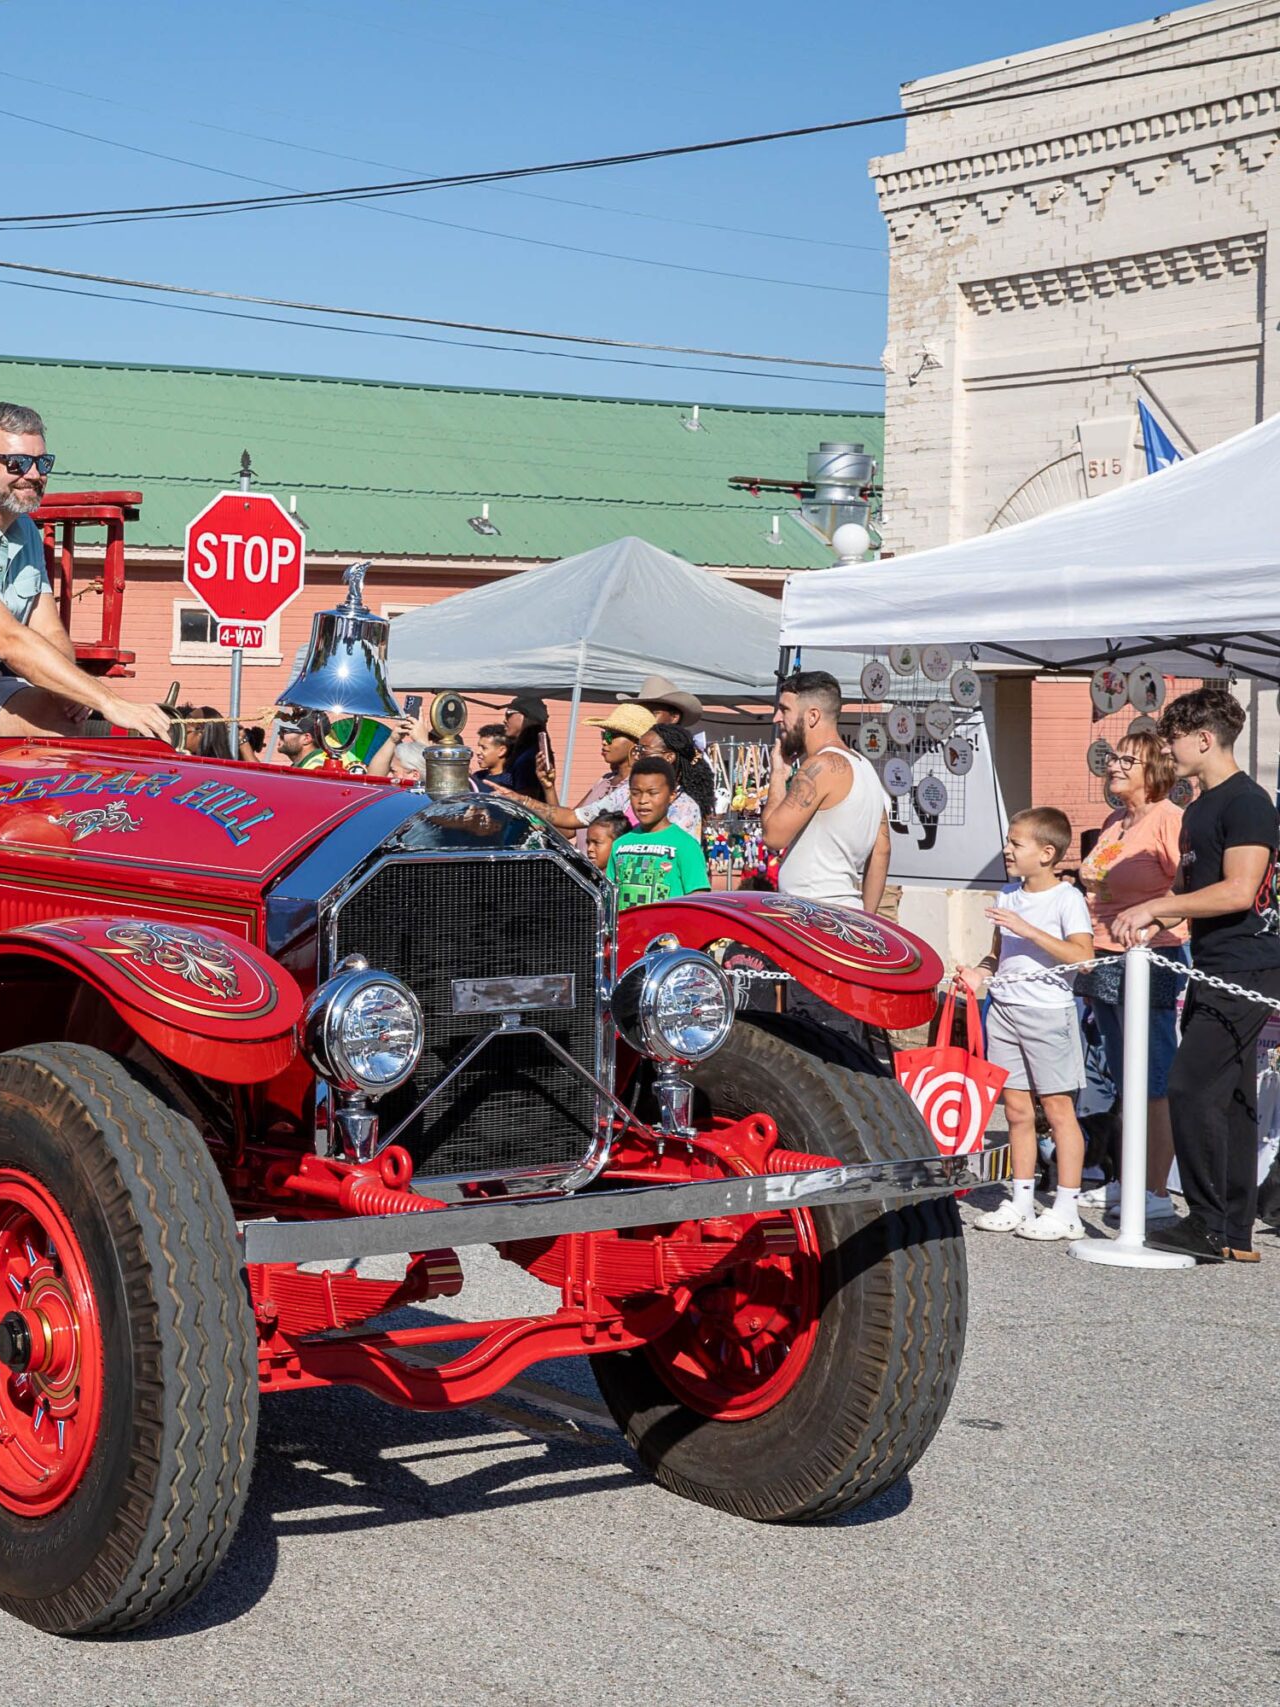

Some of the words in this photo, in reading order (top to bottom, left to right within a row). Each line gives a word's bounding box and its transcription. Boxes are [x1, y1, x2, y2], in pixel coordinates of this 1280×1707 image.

[1088, 458, 1122, 479] 515
[193, 531, 296, 584] STOP
[220, 629, 262, 647] 4-WAY
[171, 779, 277, 848] HILL
[616, 843, 677, 860] MINECRAFT
